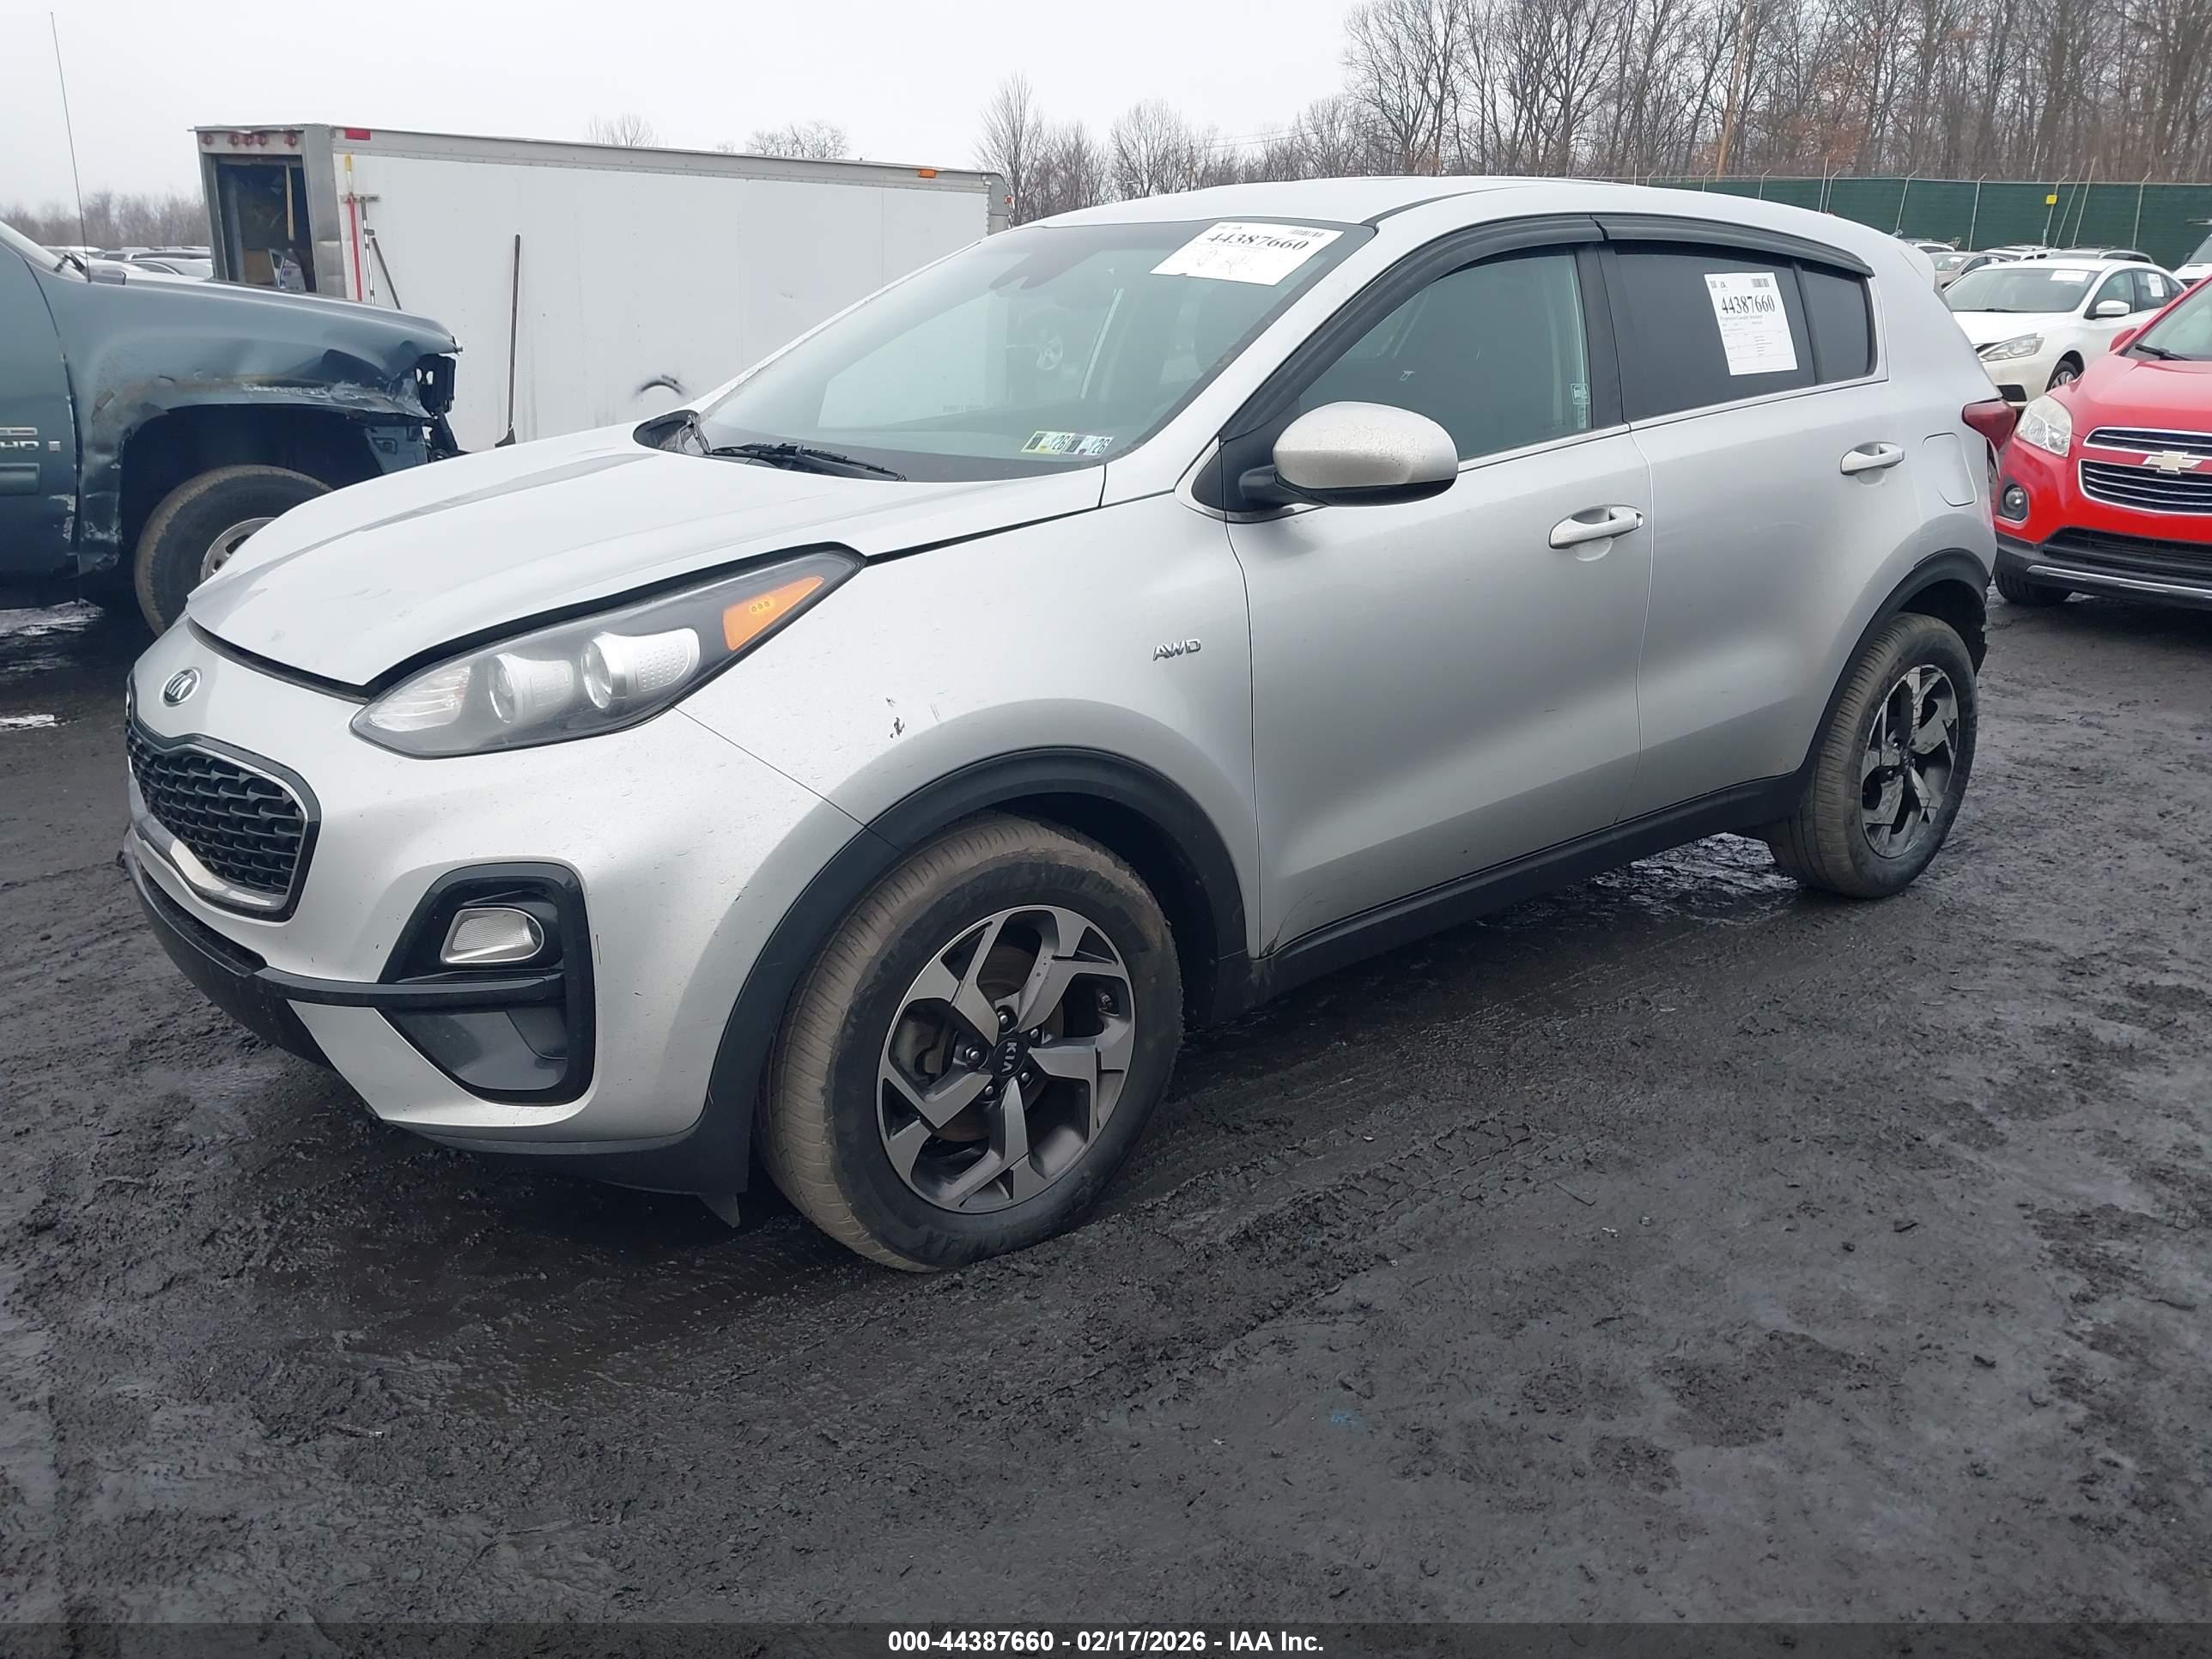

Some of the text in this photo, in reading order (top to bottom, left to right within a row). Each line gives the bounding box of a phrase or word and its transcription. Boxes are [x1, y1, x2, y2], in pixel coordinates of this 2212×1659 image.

[1206, 233, 1310, 251] 44387660
[1722, 295, 1775, 313] 44387660
[1152, 638, 1201, 661] AWD
[1001, 1042, 1018, 1073] KIA
